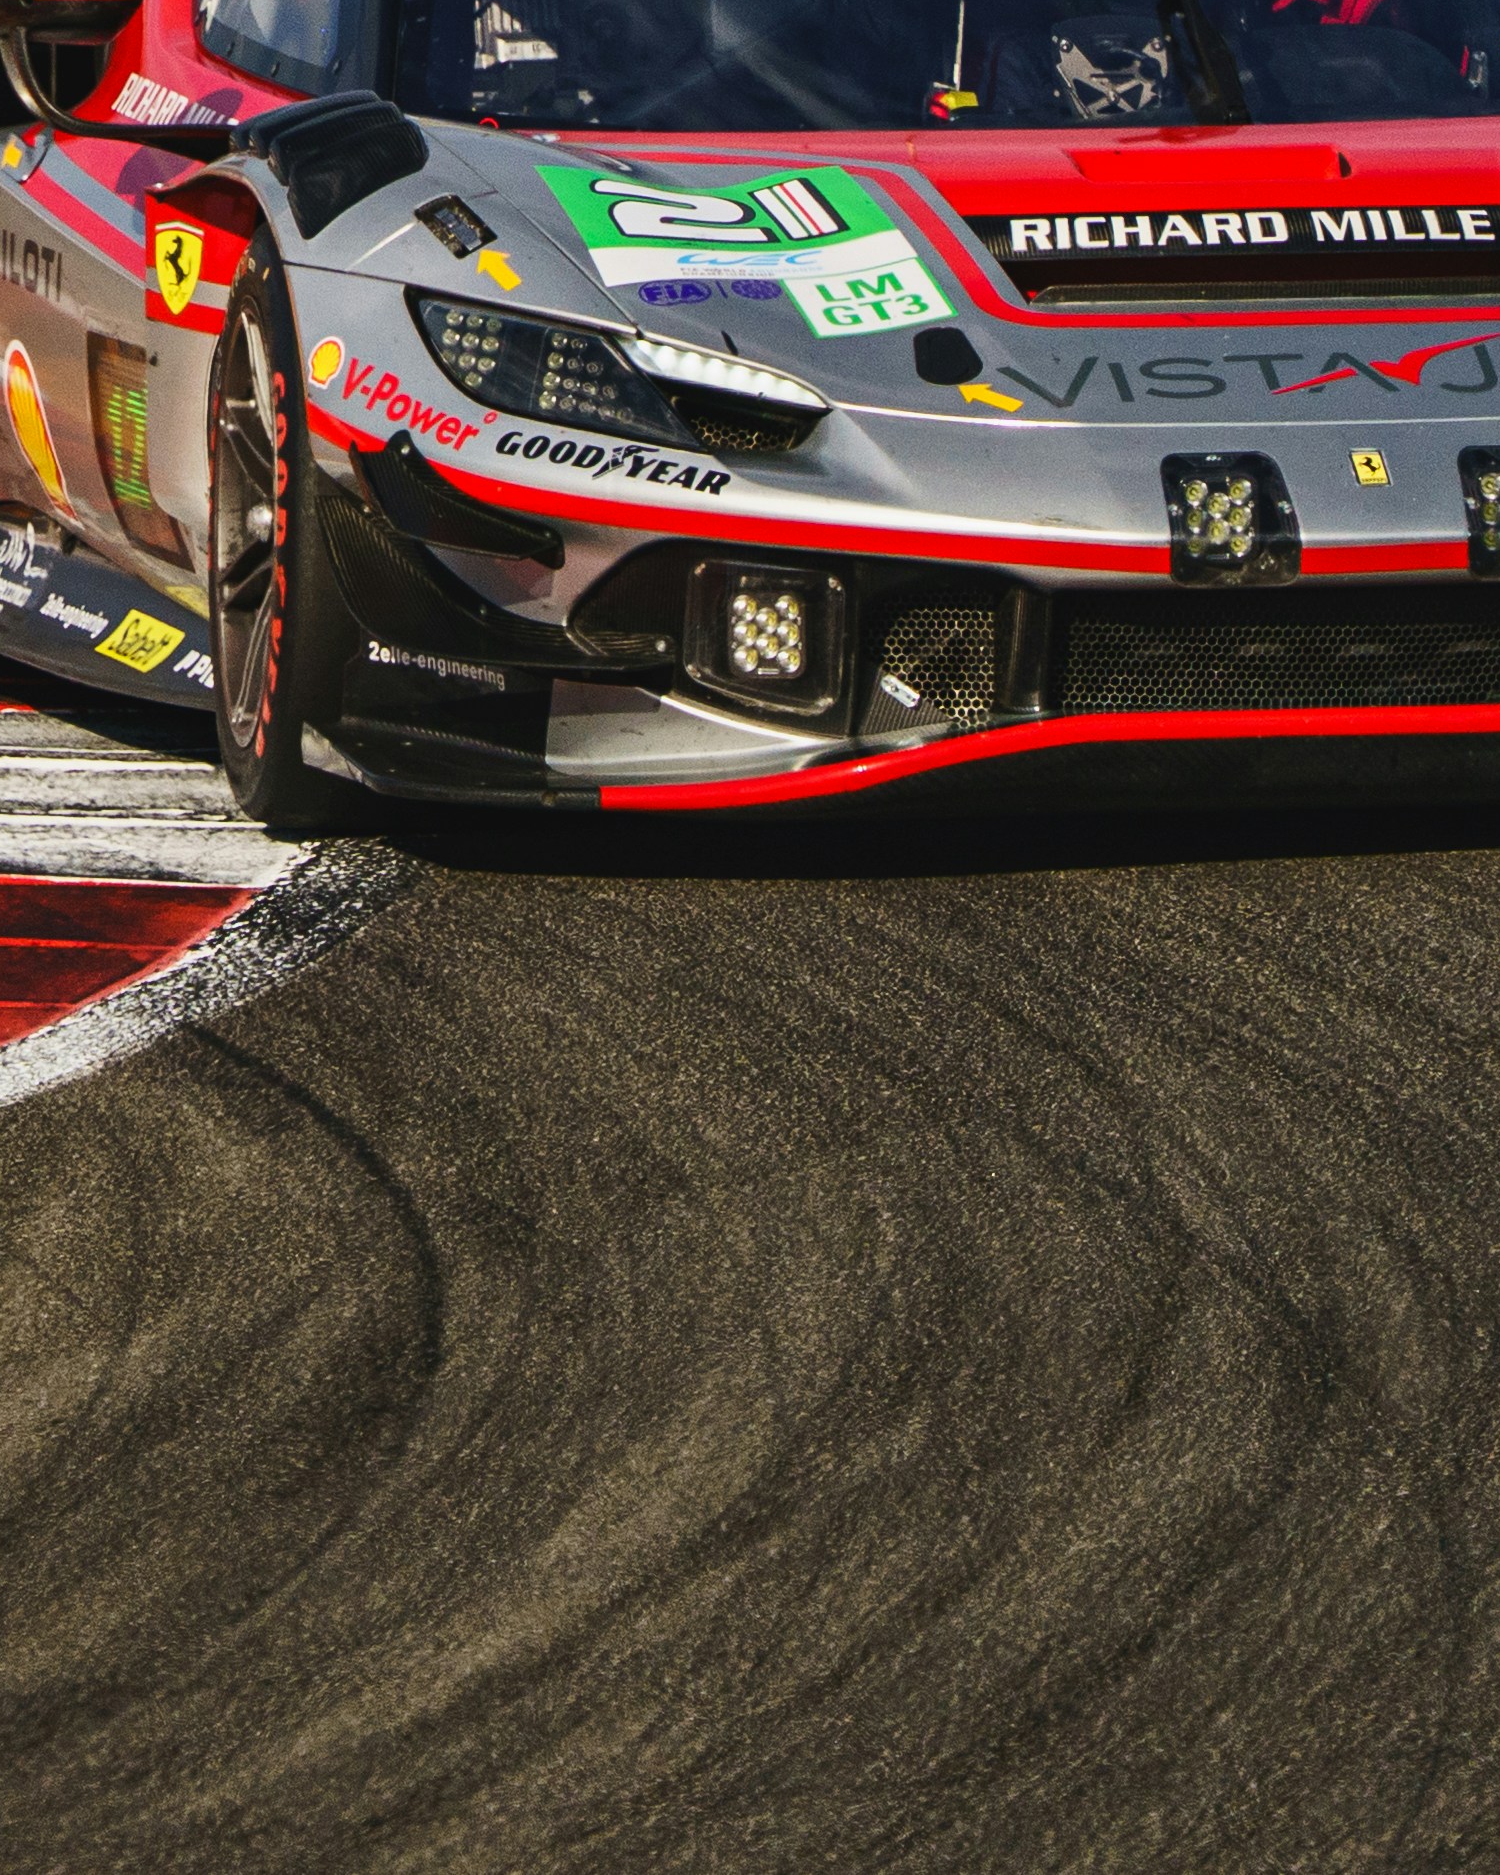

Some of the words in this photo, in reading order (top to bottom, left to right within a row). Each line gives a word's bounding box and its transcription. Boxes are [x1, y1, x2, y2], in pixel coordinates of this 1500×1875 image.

[111, 71, 190, 126] RICHARD
[590, 177, 852, 244] 21
[1010, 210, 1290, 253] RICHARD
[1311, 208, 1497, 243] MILLE
[643, 283, 707, 303] FIA
[815, 272, 906, 304] LM
[822, 293, 931, 327] GT3
[341, 356, 481, 453] V-Power
[495, 431, 732, 497] GOODYEAR
[368, 640, 506, 693] 2elle-engineering
